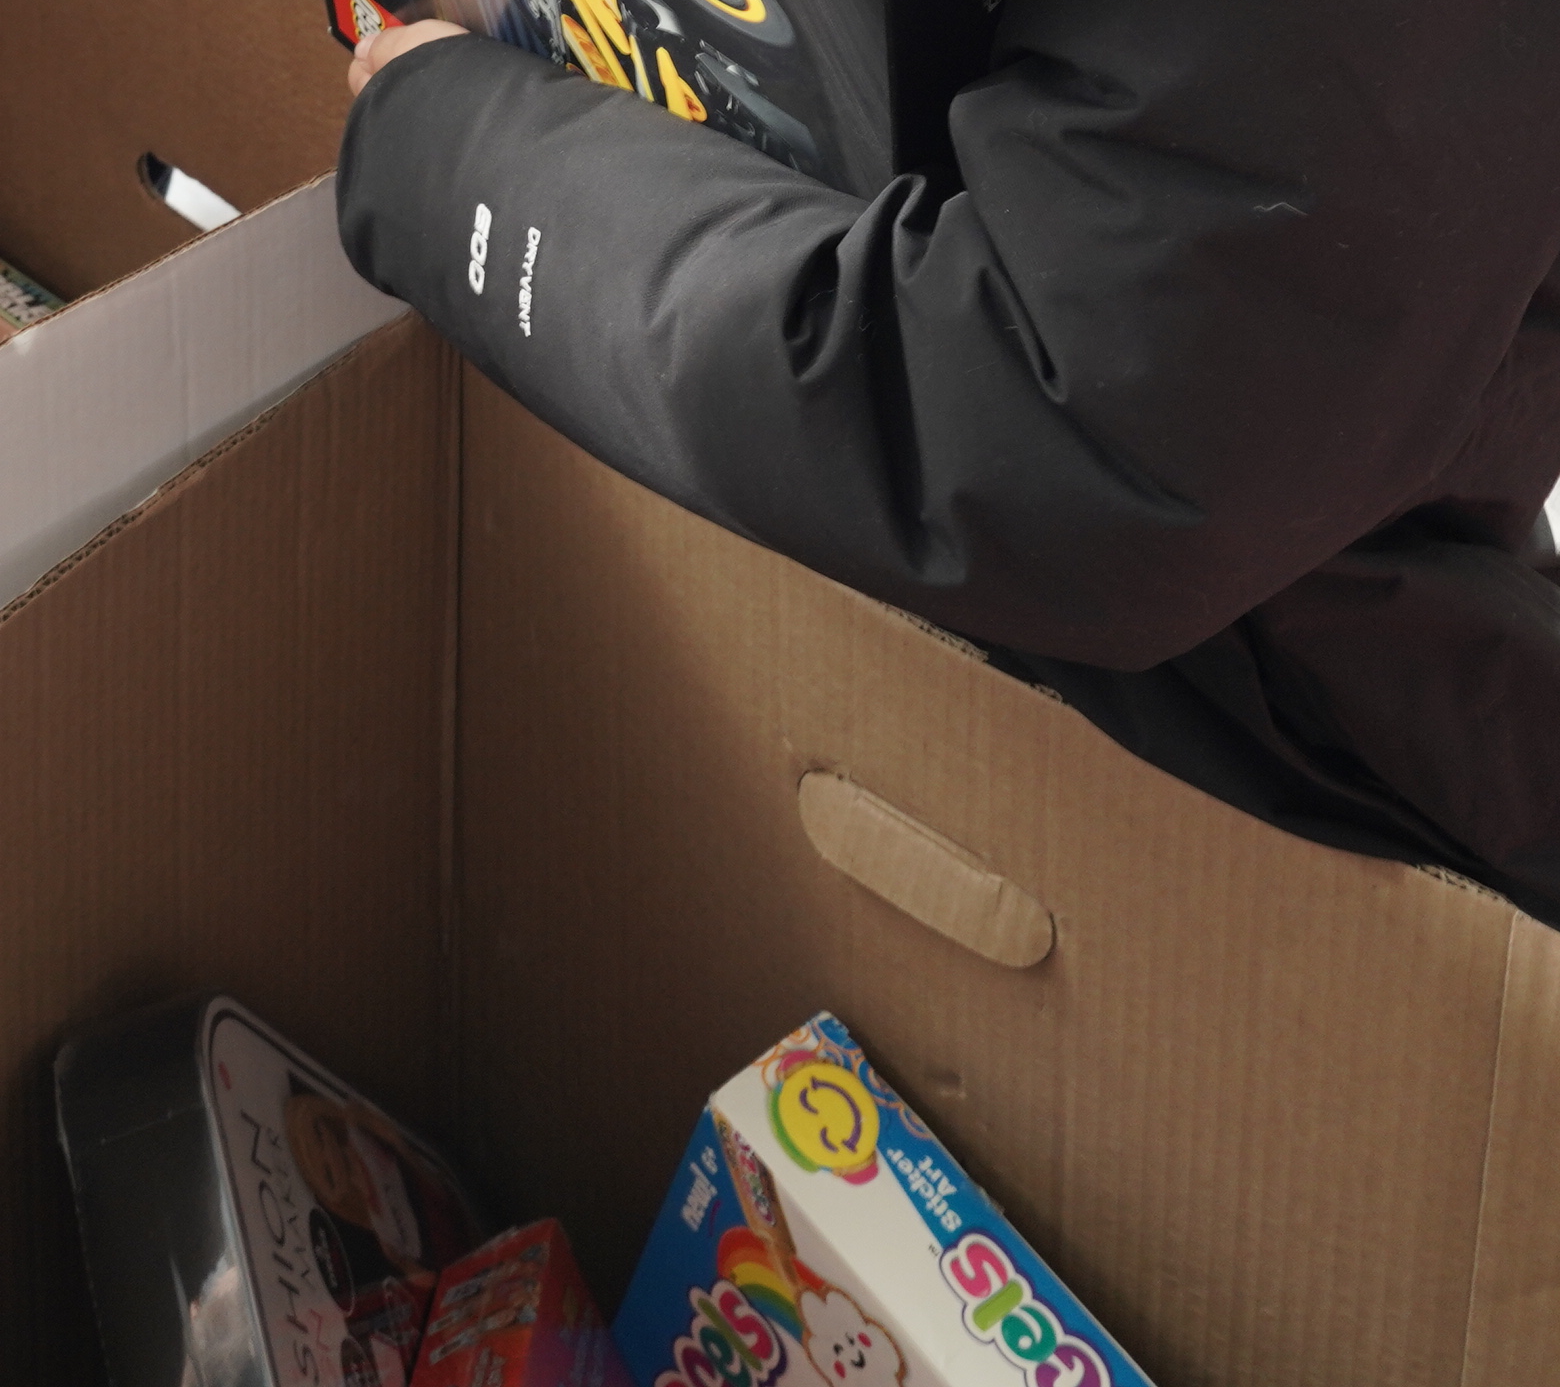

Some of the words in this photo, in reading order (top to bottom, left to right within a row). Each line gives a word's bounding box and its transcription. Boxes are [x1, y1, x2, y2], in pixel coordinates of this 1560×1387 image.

[518, 226, 541, 338] DRYVENT
[683, 1163, 718, 1231] new!
[888, 1147, 963, 1233] Sticker
[918, 1154, 957, 1201] Art
[658, 1285, 776, 1387] cels
